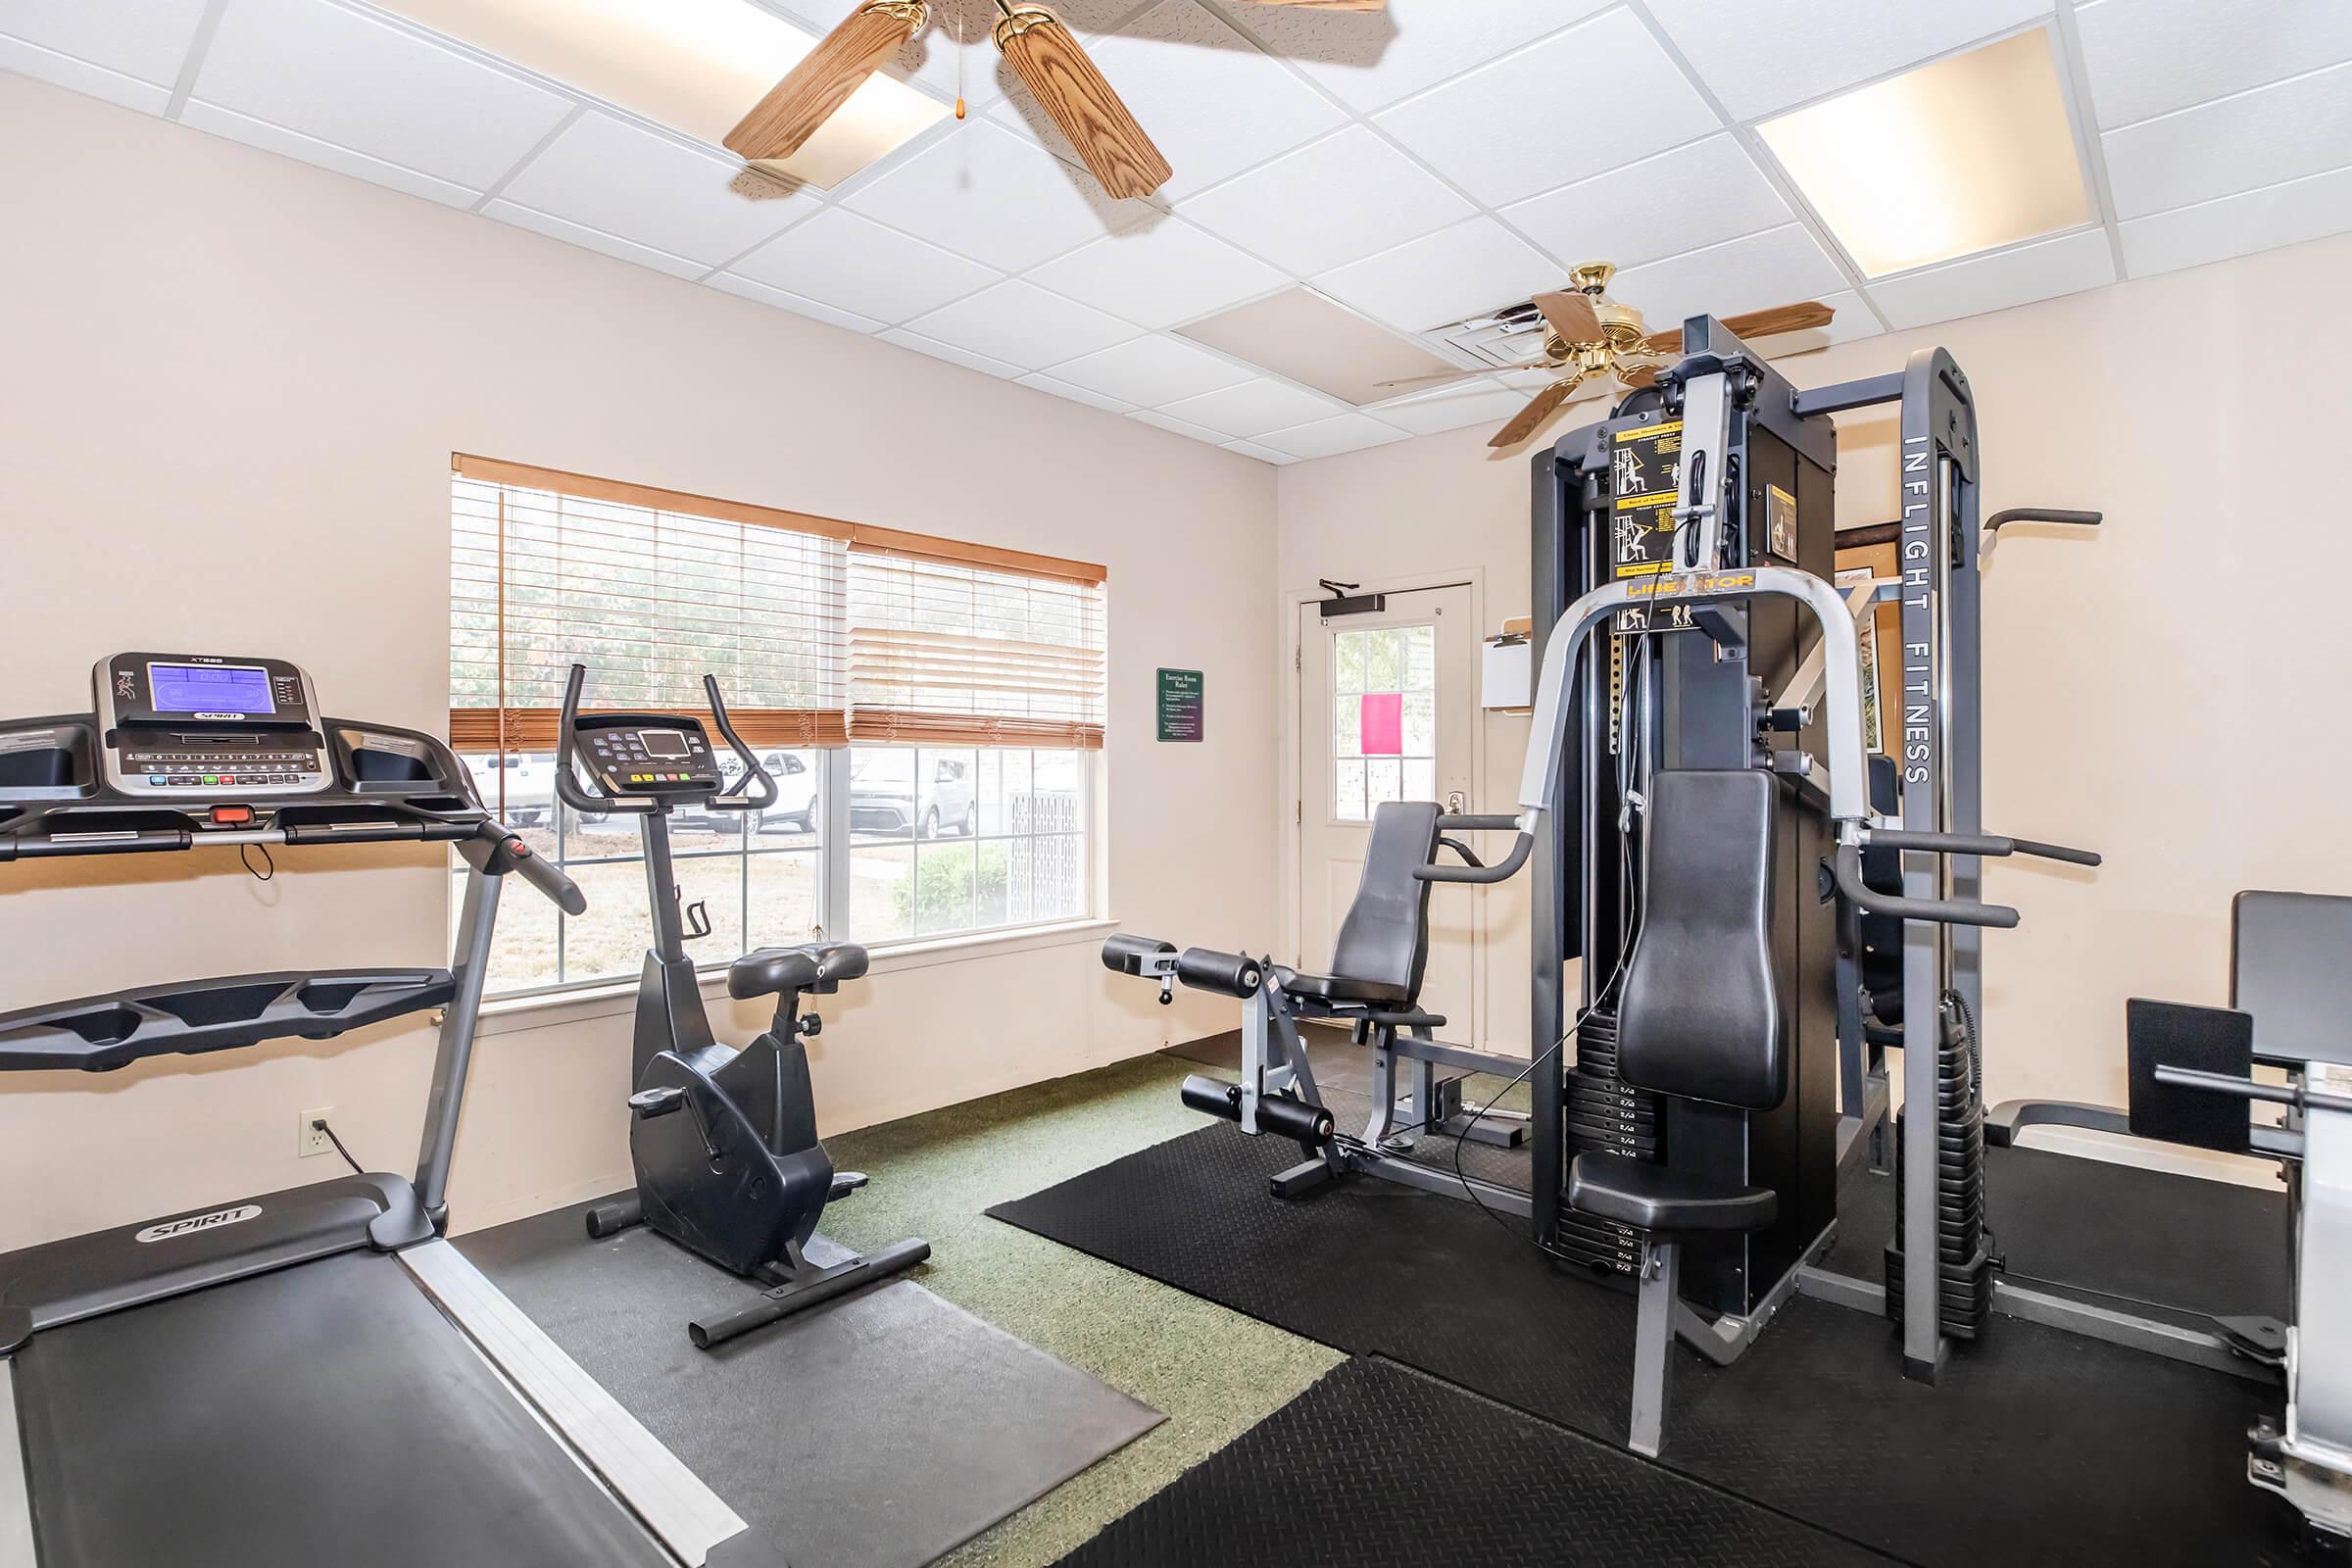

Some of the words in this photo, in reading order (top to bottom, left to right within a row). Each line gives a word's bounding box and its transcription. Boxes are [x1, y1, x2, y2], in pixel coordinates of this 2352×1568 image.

[1903, 436, 1930, 611] INFLIGHT
[1628, 575, 1754, 596] LIBETOR
[1905, 642, 1933, 786] FITNESS
[150, 1207, 251, 1238] SPIRIT
